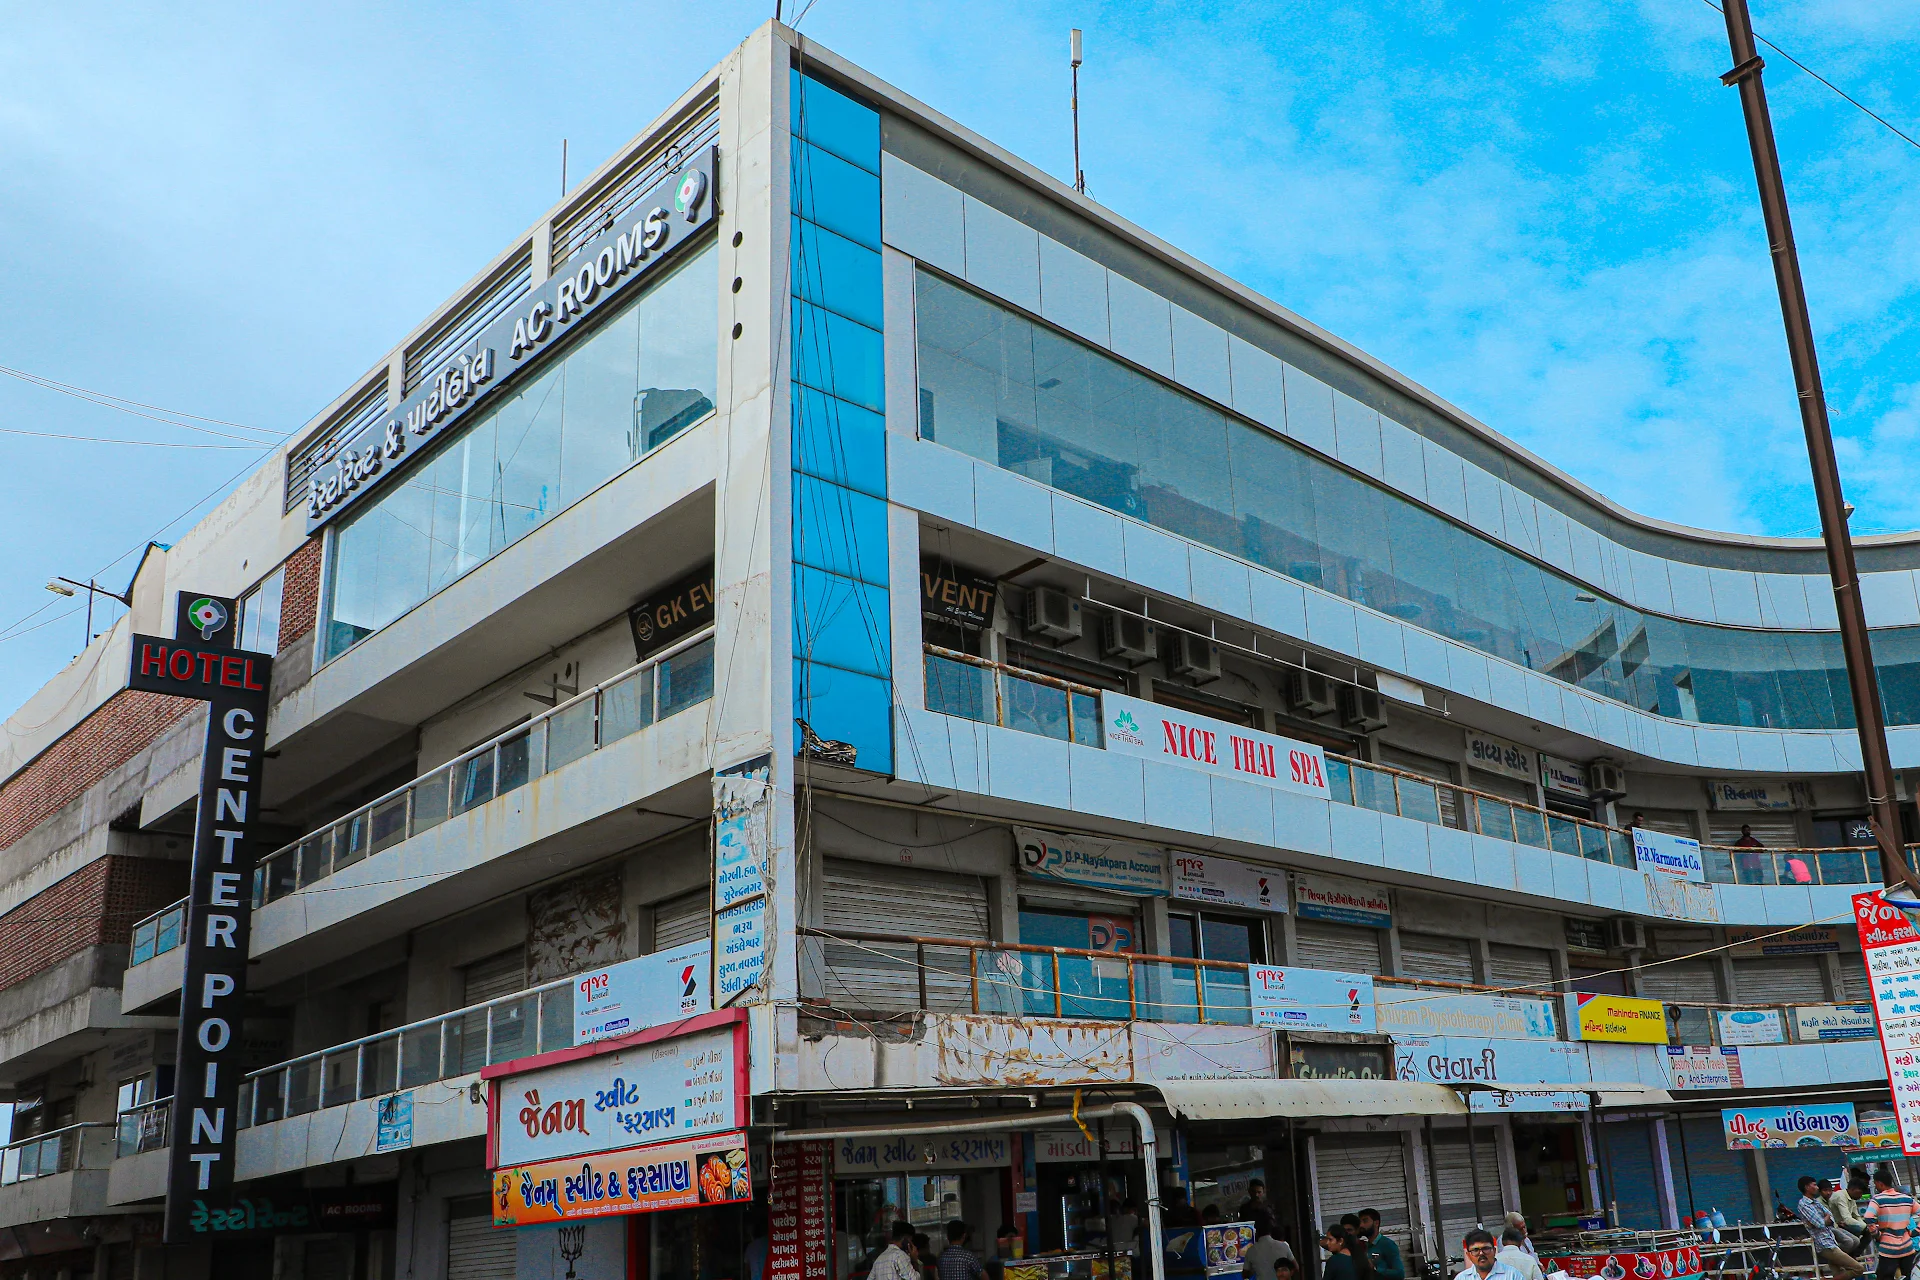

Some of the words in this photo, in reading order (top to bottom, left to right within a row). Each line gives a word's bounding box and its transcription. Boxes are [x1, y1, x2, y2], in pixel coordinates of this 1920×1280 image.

[384, 420, 404, 459] &
[510, 301, 552, 360] AC
[558, 207, 669, 323] ROOMS
[656, 595, 687, 628] GK
[689, 578, 714, 612] EV
[920, 572, 993, 613] VENT
[141, 644, 263, 691] HOTEL
[1109, 733, 1121, 742] NICE
[1122, 736, 1134, 744] THAI
[1134, 739, 1145, 747] SPA
[1161, 720, 1218, 765] NICE
[1230, 735, 1277, 778] THAI
[1289, 750, 1325, 788] SPA
[204, 707, 255, 949] CENTER
[1129, 859, 1162, 875] Account
[1683, 855, 1689, 869] &
[1689, 855, 1701, 871] Co.
[733, 920, 753, 936] ભરૂચ
[1377, 1003, 1420, 1025] Shivam
[1421, 1005, 1495, 1035] Physiotherapy
[1497, 1012, 1524, 1033] Clinic
[1639, 1010, 1661, 1020] FINANCE
[1427, 1048, 1498, 1081] ભવાની
[1689, 1075, 1700, 1084] And
[1700, 1074, 1728, 1085] Enterprise
[189, 973, 235, 1190] POINT
[594, 1077, 639, 1112] સ્વીટ
[519, 1088, 590, 1138] જૈનમ્
[617, 1111, 624, 1123] &
[624, 1106, 676, 1134] ફરસાણ
[1775, 1110, 1851, 1134] પાંઉભાજી
[841, 1137, 880, 1169] જૈનમ્
[883, 1136, 917, 1164] સ્વીટ
[951, 1136, 1005, 1163] ફરસાણ
[520, 1172, 564, 1217] જૈનમ્
[565, 1162, 605, 1204] સ્વીટ
[607, 1170, 622, 1199] &
[626, 1159, 692, 1201] ફરસાણ
[327, 1205, 341, 1215] AC
[345, 1203, 383, 1214] ROOMS
[772, 1213, 797, 1227] પારલેજી
[772, 1244, 797, 1254] ખાખરા
